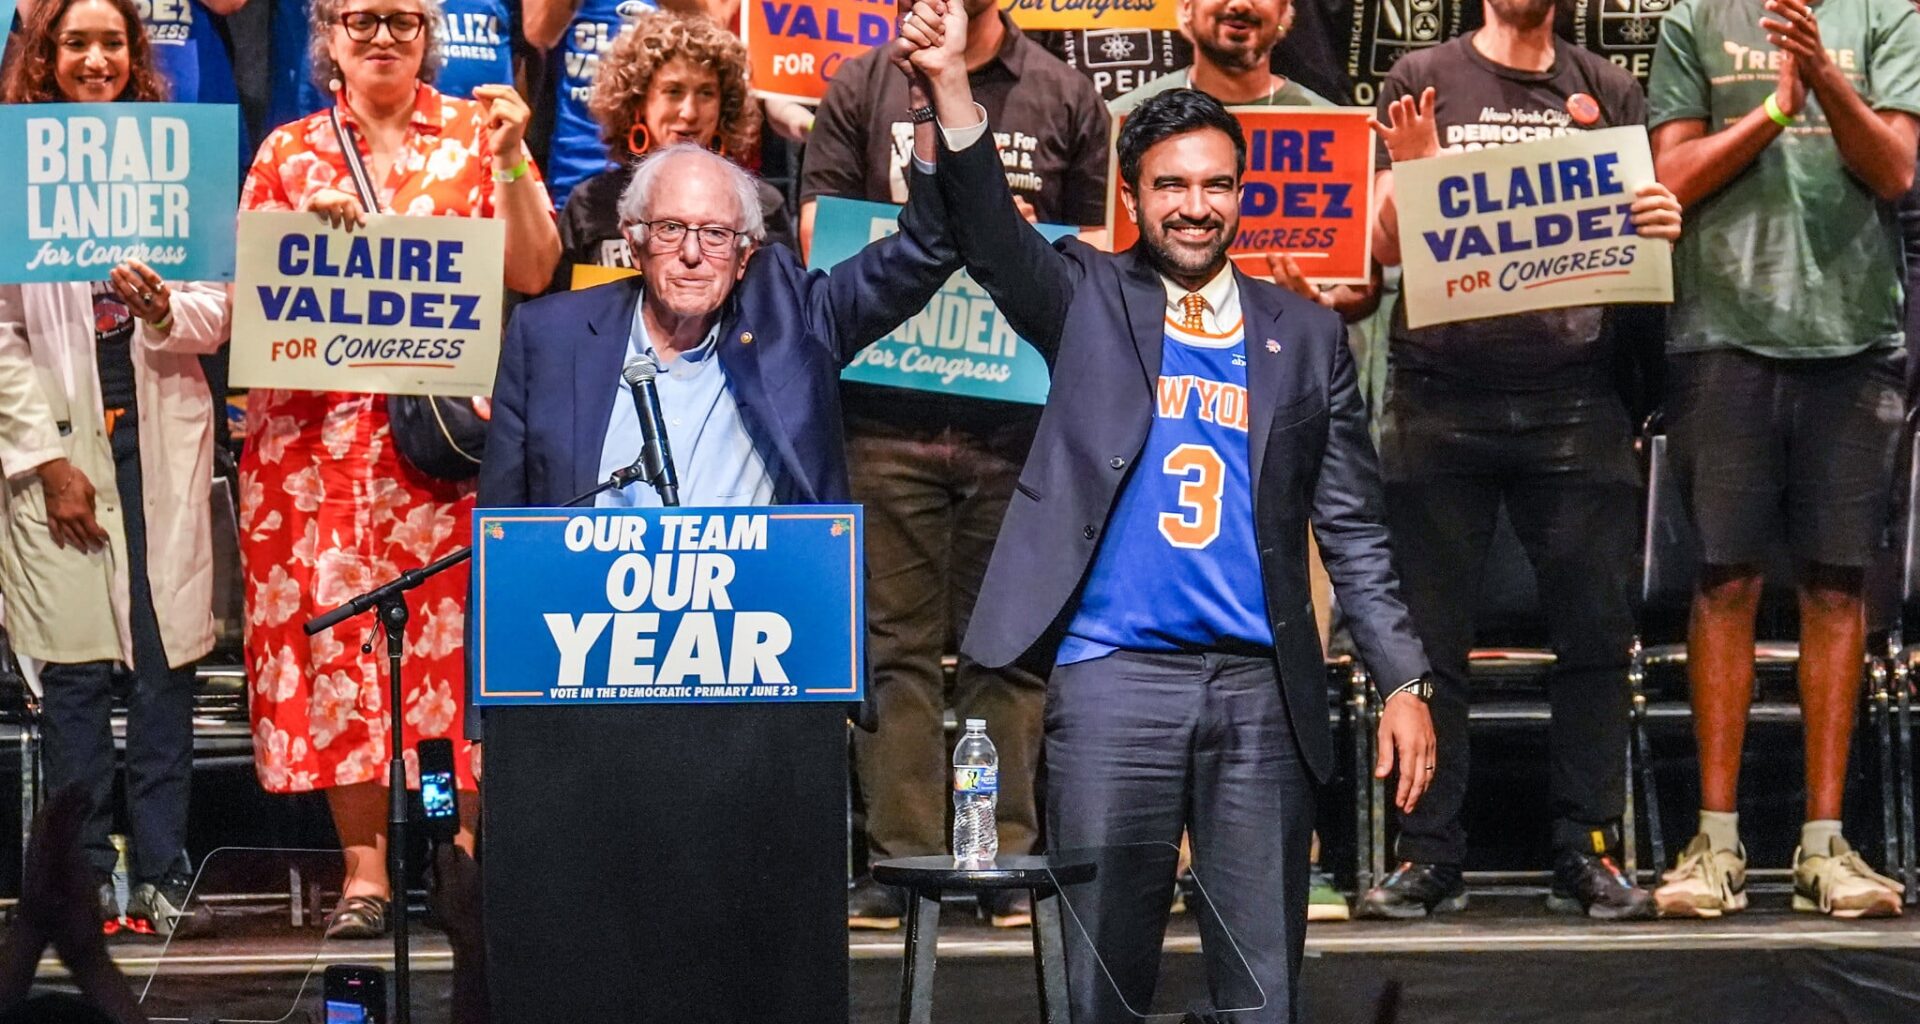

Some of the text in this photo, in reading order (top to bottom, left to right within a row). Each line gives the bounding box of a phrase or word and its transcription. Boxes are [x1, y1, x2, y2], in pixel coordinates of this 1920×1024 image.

[762, 1, 900, 47] VALD
[772, 53, 815, 76] FOR
[571, 86, 595, 101] FO
[1480, 107, 1572, 127] New York City
[27, 117, 190, 184] BRAD
[1013, 131, 1038, 151] For
[1246, 129, 1335, 173] IRE
[1020, 152, 1033, 169] &
[1005, 171, 1043, 191] omic
[1438, 152, 1624, 218] CLAIRE
[28, 183, 190, 240] LANDER
[1241, 182, 1354, 218] DEZ
[1232, 227, 1337, 249] NGRESS
[1423, 203, 1637, 262] VALDEZ
[26, 240, 186, 270] for Congress
[278, 233, 464, 283] CLAIRE
[1446, 271, 1491, 297] FOR
[256, 285, 481, 330] VALDEZ
[271, 338, 317, 361] FOR
[901, 346, 1011, 384] Congress
[1158, 443, 1226, 550] 3
[564, 515, 768, 552] OUR TEAM
[606, 553, 737, 612] OUR
[543, 611, 793, 686] YEAR
[550, 686, 798, 699] VOTE IN THE DEMOCRATIC PRIMARY JUNE 23
